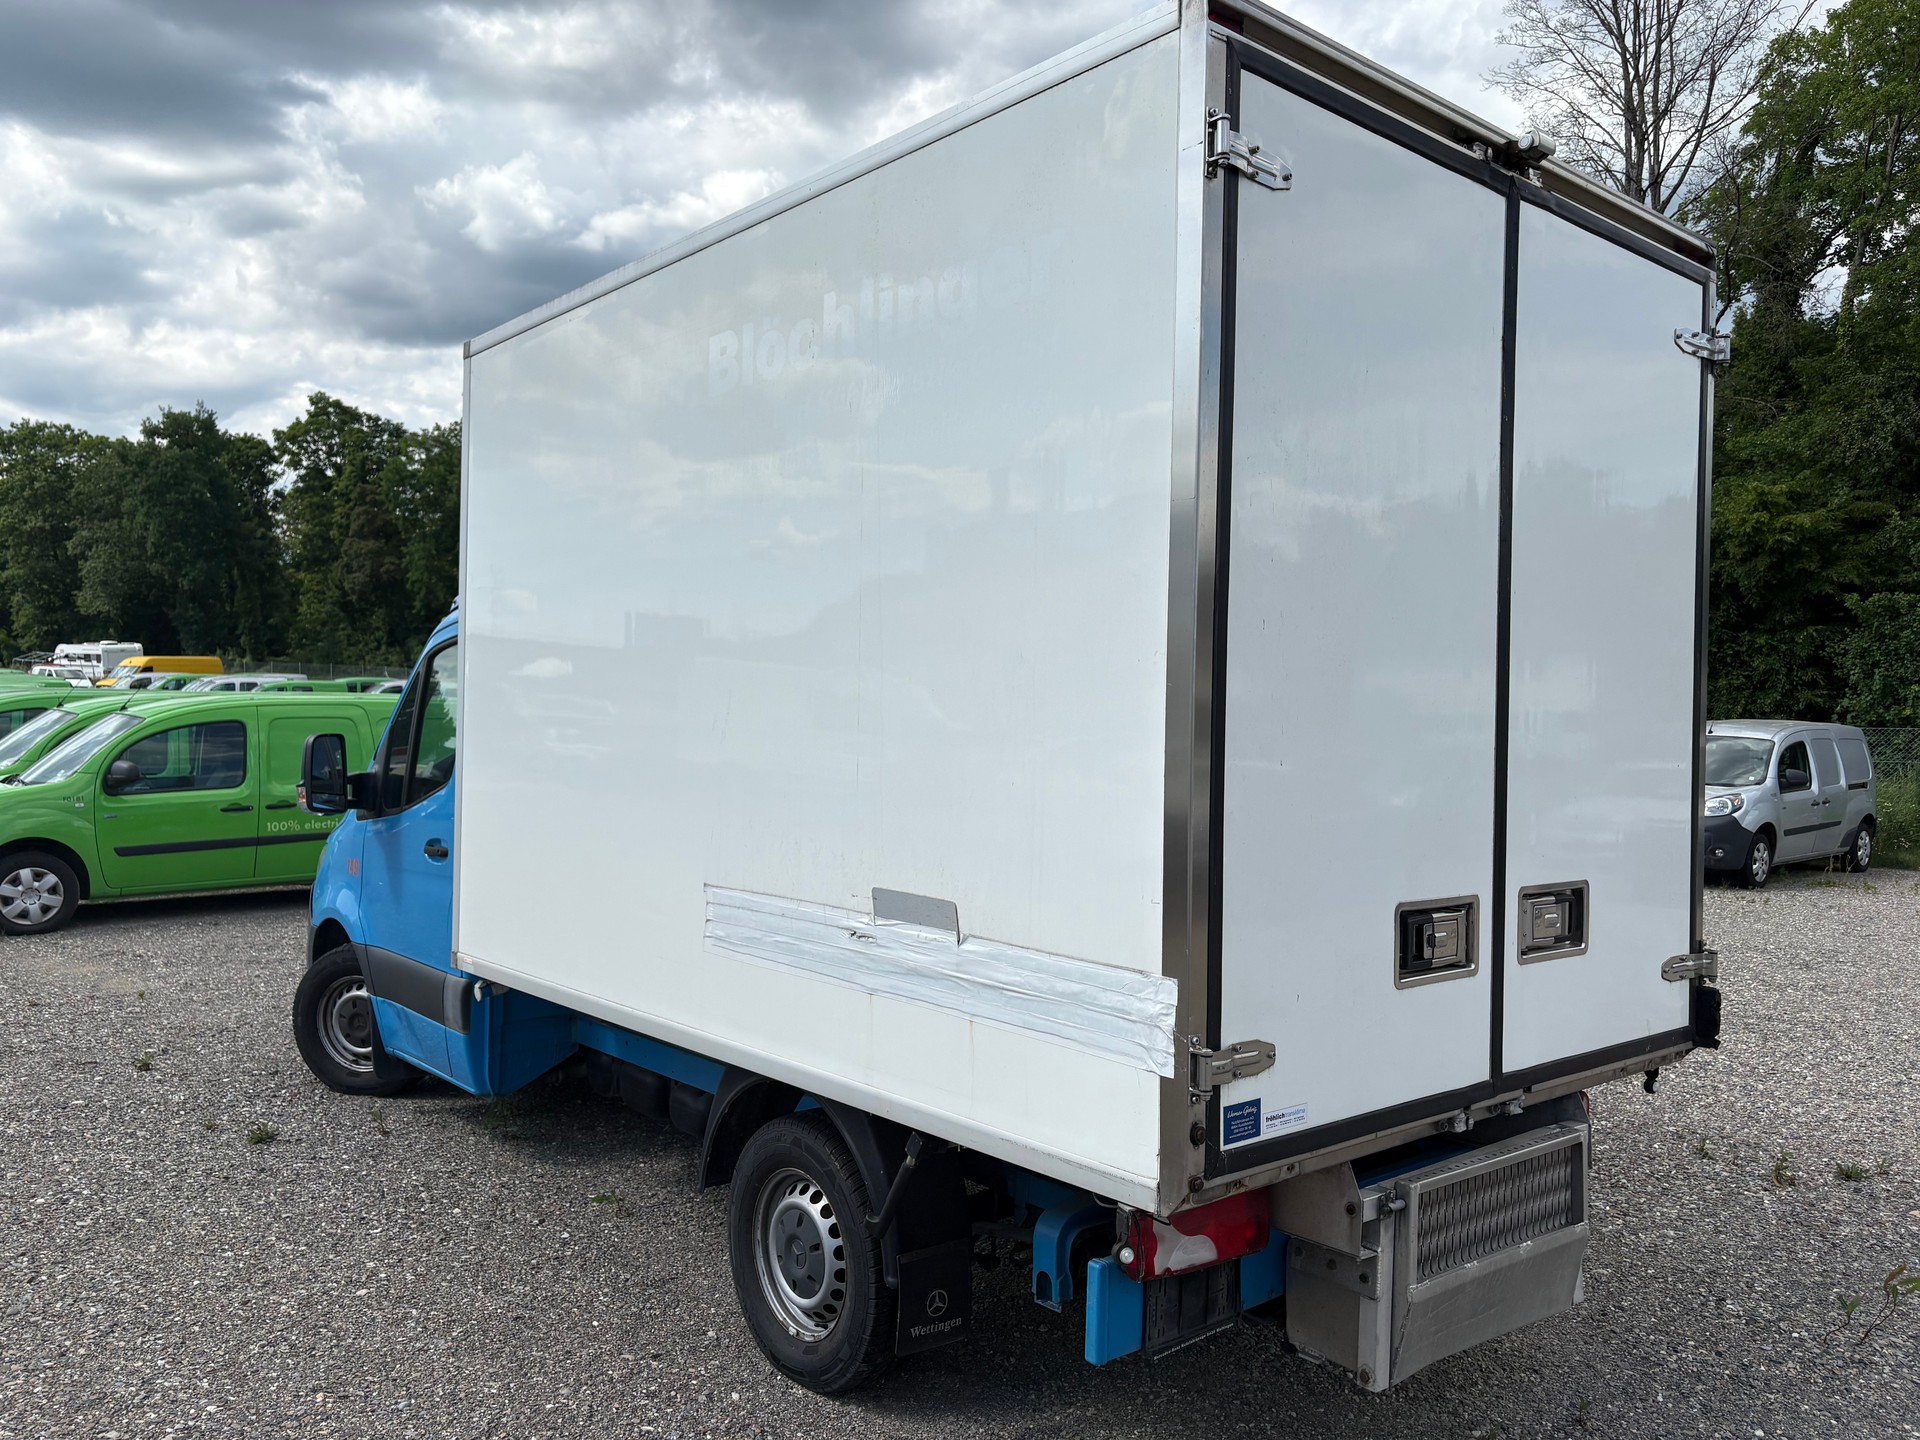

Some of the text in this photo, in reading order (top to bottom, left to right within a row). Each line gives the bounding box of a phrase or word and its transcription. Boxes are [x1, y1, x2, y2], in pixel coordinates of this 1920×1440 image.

[266, 818, 339, 832] 100% electri
[347, 856, 359, 877] 149
[910, 1317, 962, 1339] Wettingen
